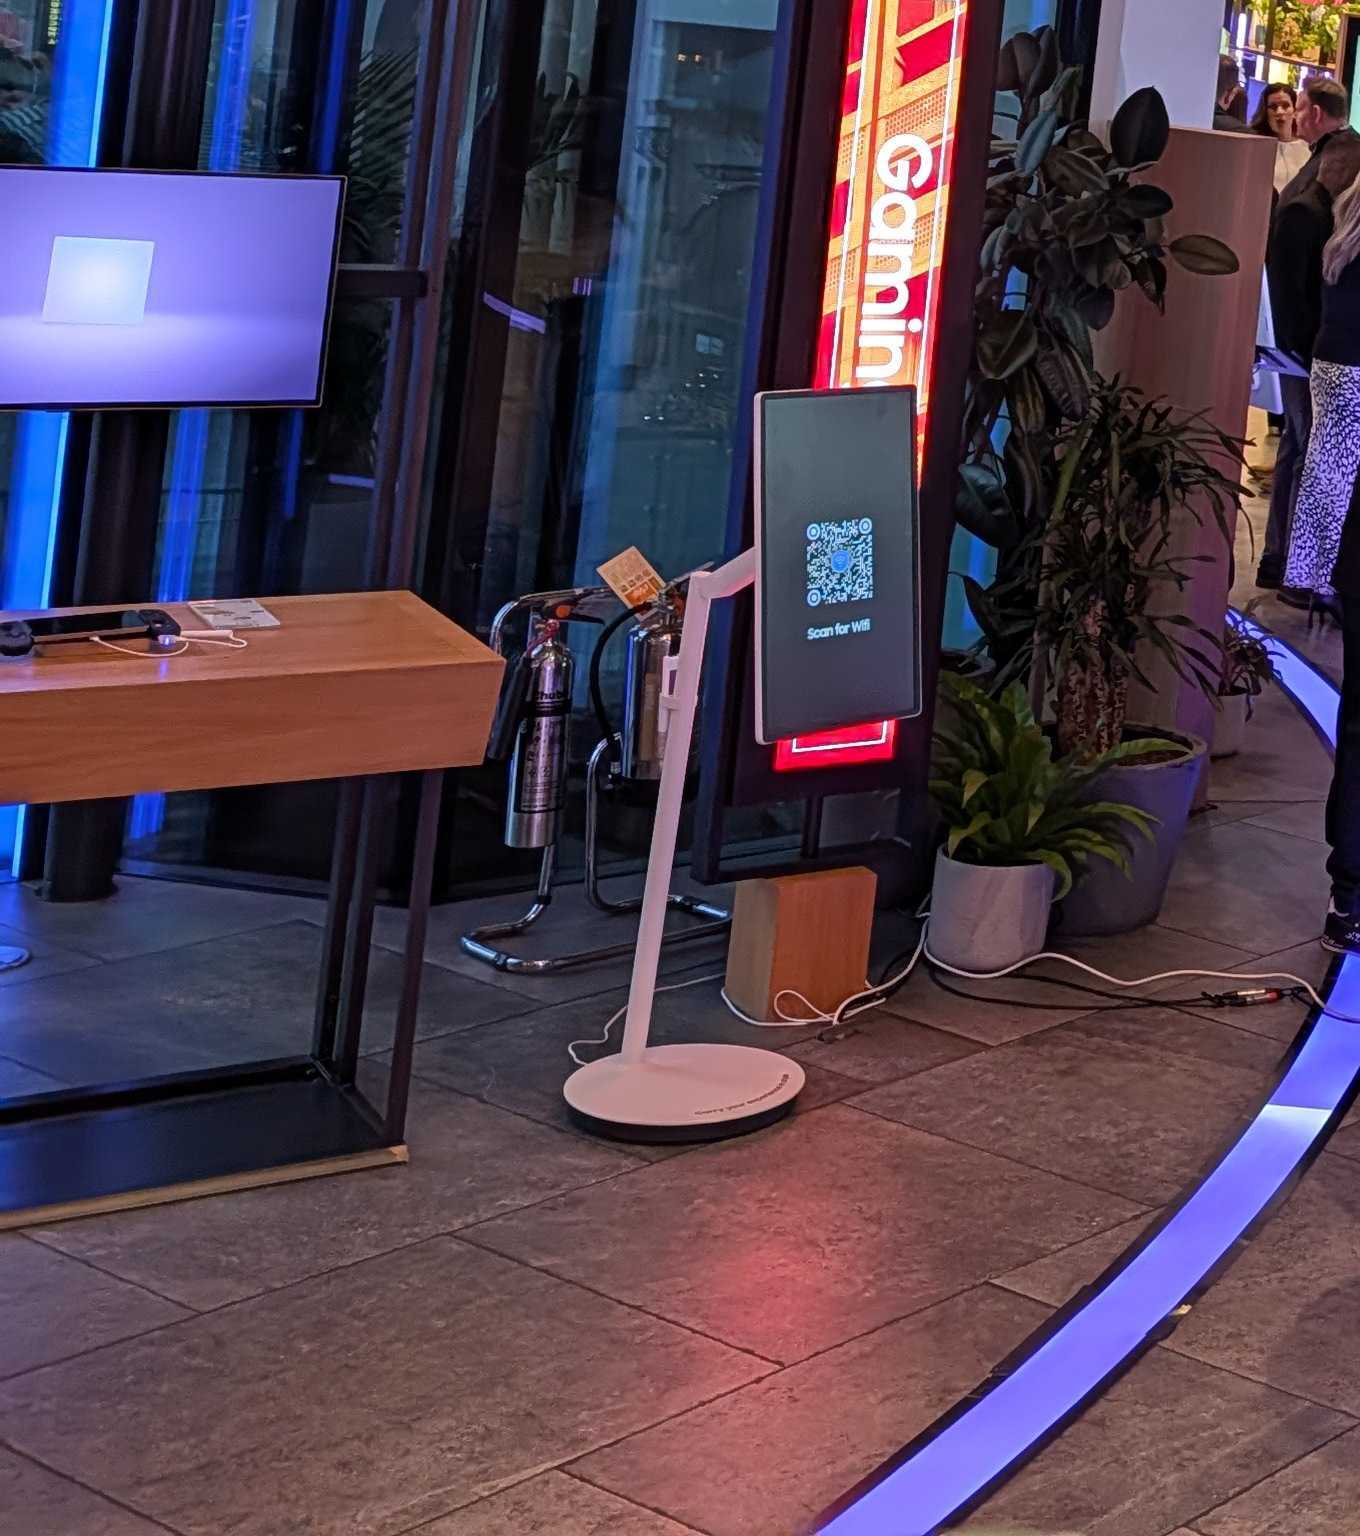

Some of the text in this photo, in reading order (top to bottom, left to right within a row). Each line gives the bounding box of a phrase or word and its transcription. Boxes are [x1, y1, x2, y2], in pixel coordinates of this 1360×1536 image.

[842, 132, 936, 388] Gamin
[807, 618, 871, 640] Scan for Wifi
